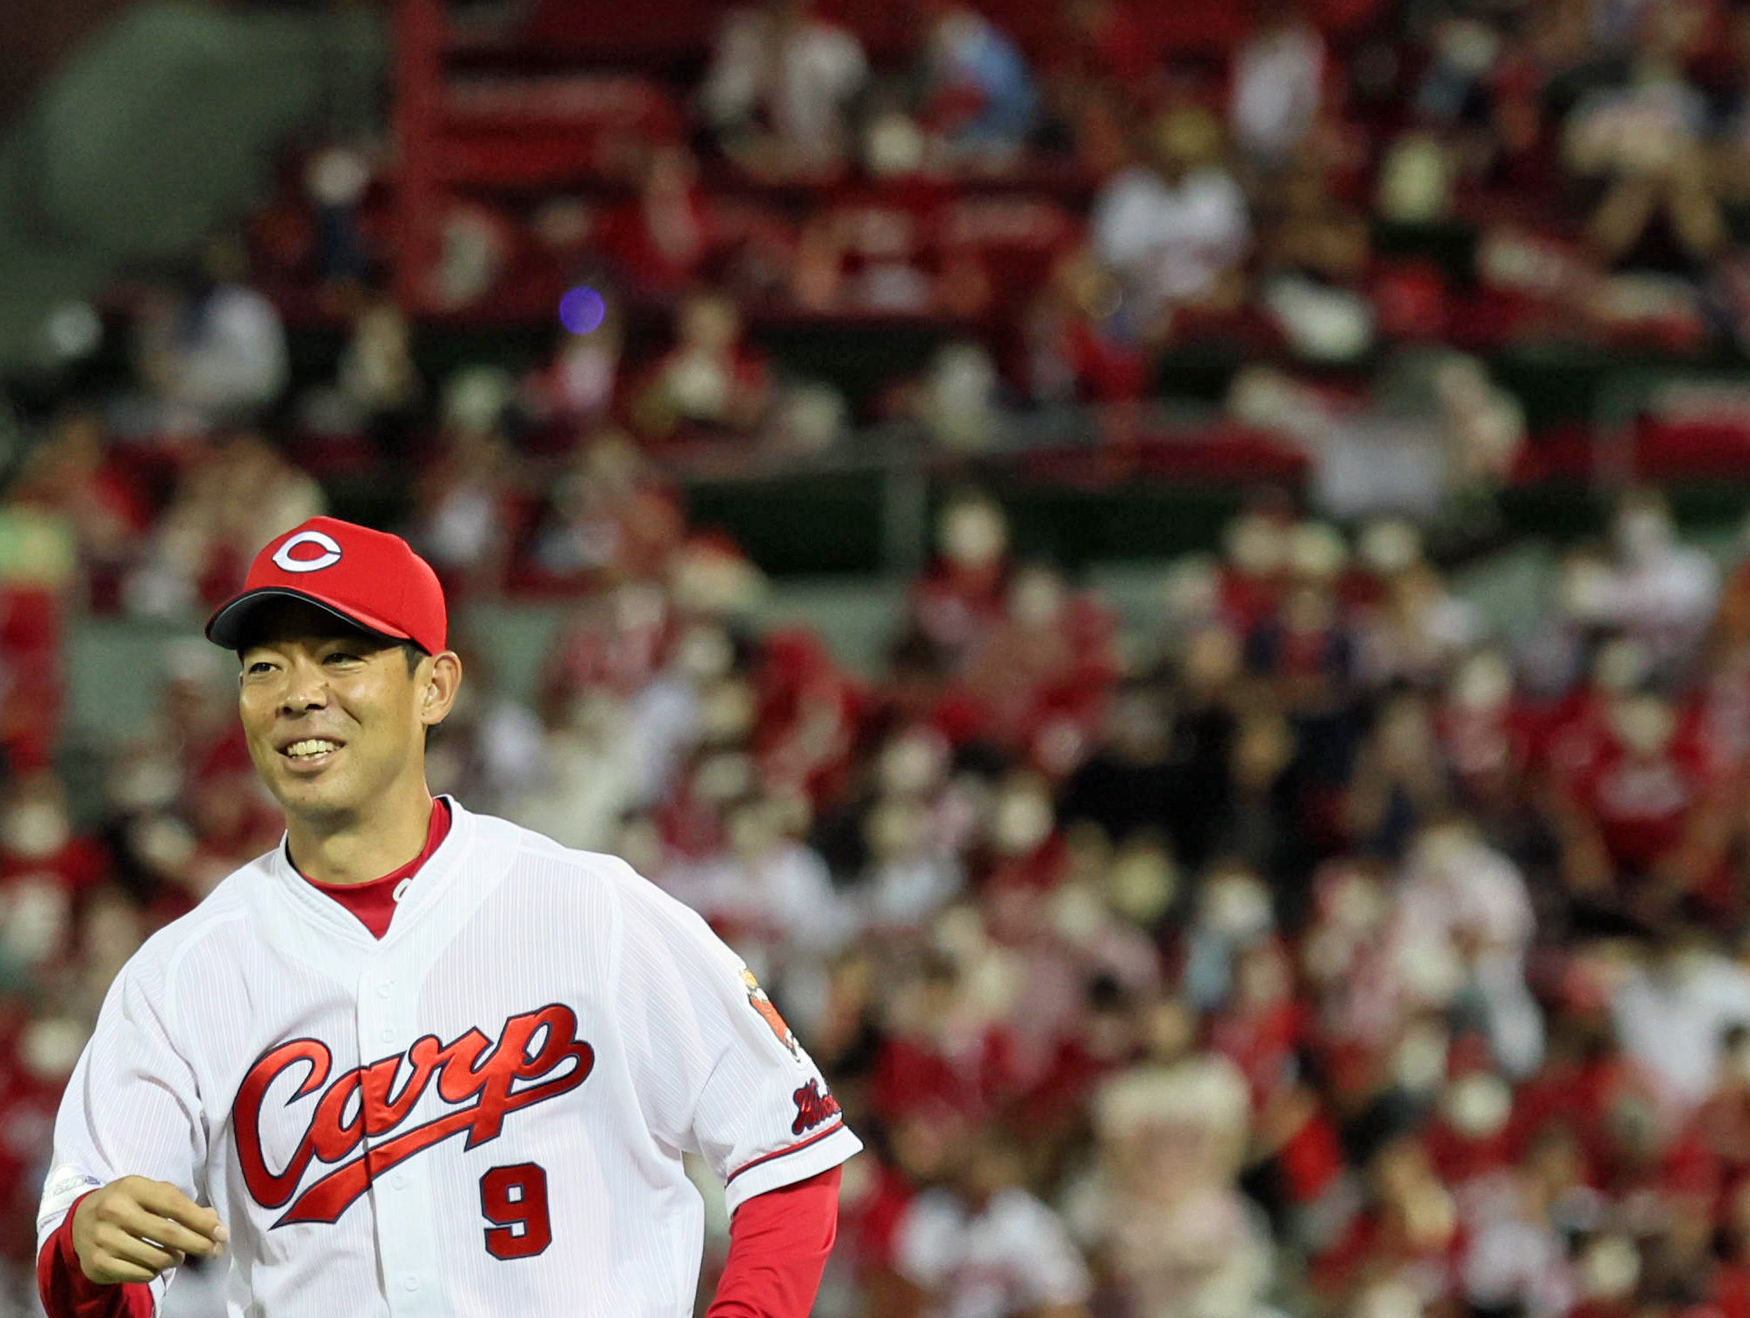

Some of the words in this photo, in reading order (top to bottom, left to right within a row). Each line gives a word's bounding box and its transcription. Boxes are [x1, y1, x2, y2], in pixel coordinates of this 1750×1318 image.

[271, 530, 343, 573] C
[232, 1003, 596, 1230] Carp
[478, 1162, 552, 1260] 9
